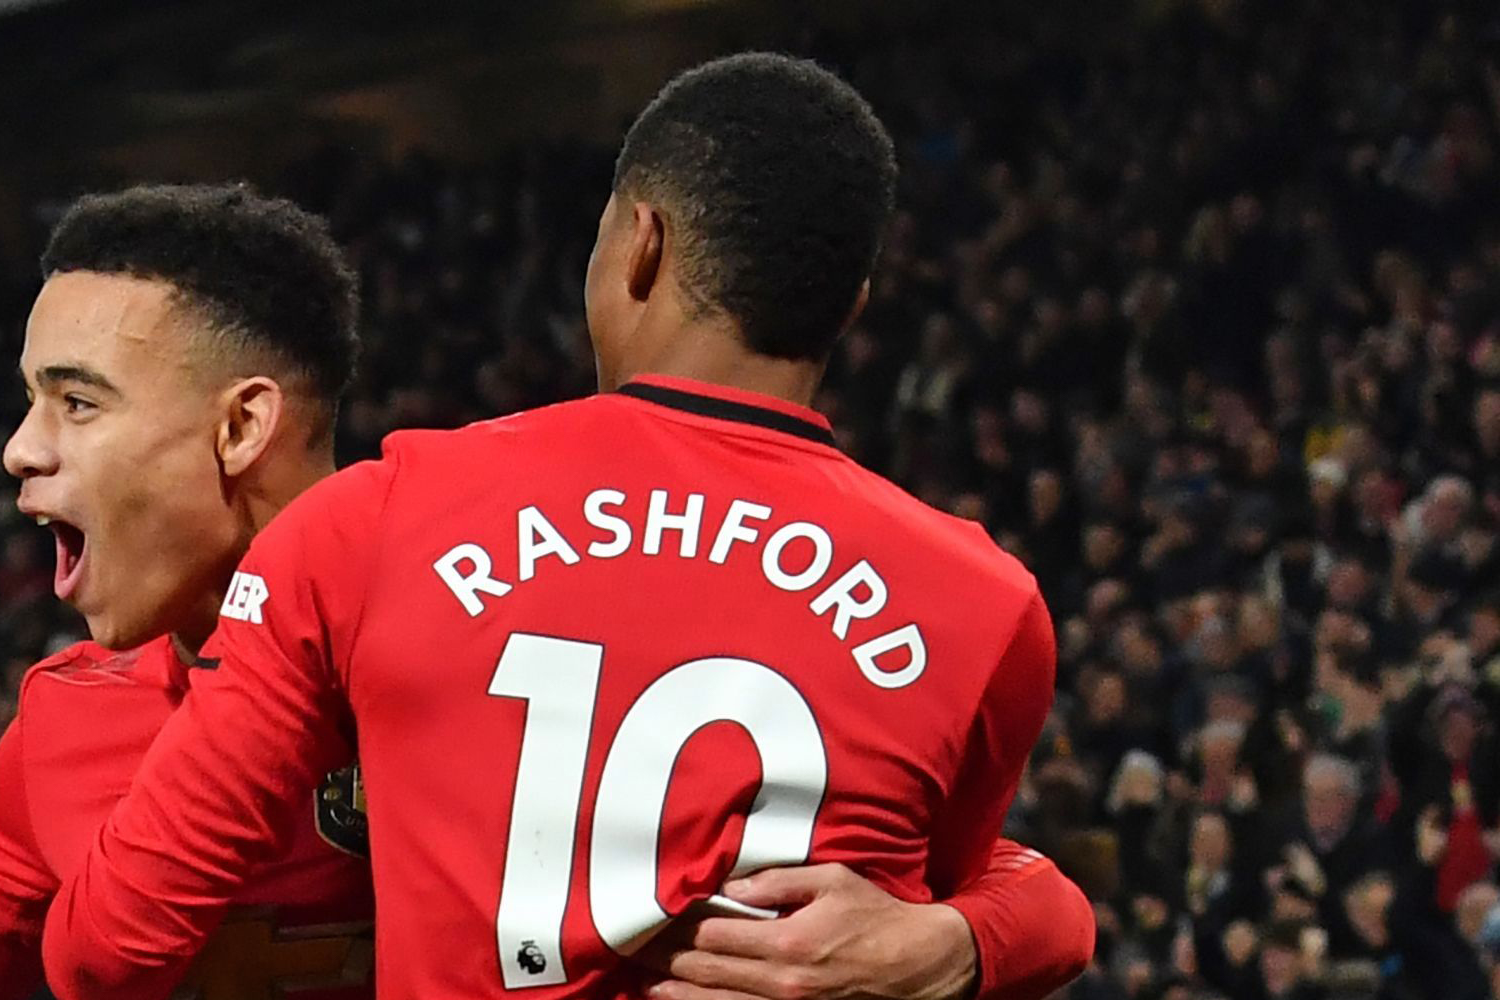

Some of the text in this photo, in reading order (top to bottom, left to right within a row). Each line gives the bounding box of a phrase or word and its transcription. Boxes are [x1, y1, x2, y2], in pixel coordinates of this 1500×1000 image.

[219, 571, 270, 624] LER
[433, 488, 928, 690] RASHFORD
[487, 631, 829, 990] 10
